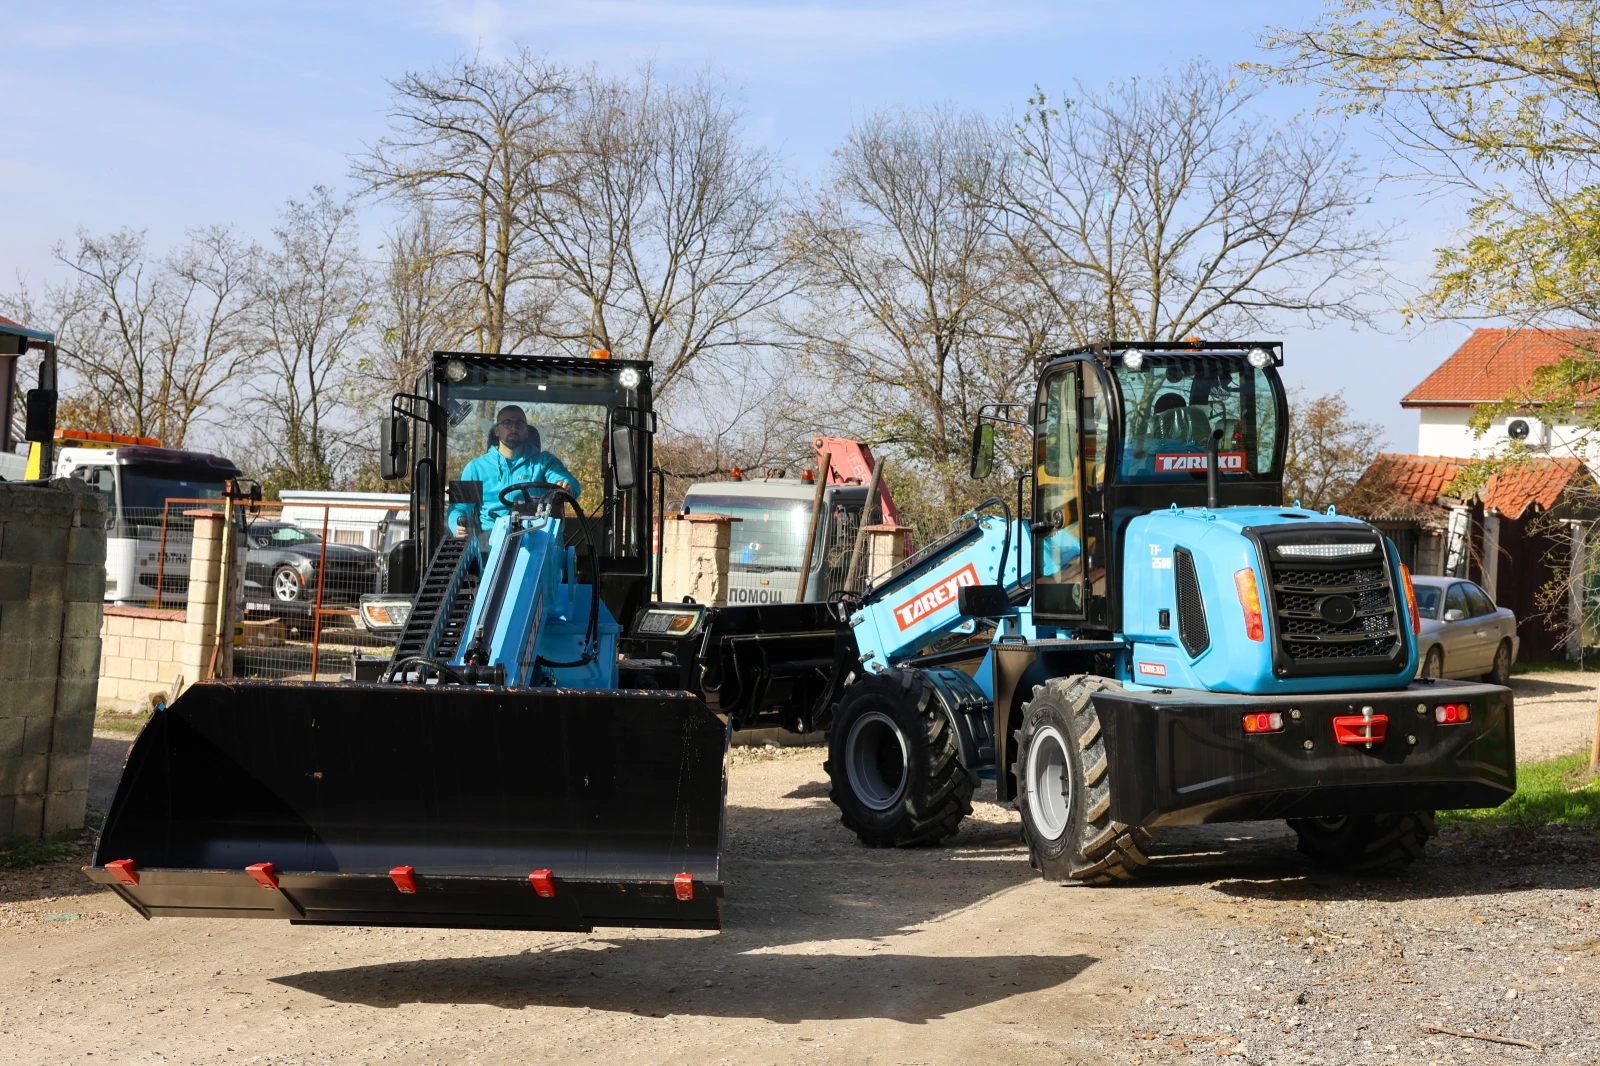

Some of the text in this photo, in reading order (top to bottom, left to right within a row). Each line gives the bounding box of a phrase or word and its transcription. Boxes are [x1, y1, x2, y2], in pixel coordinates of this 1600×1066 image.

[728, 588, 783, 605] ПОМОЩ
[896, 568, 976, 626] TAREXO
[1139, 663, 1166, 675] TAREXO
